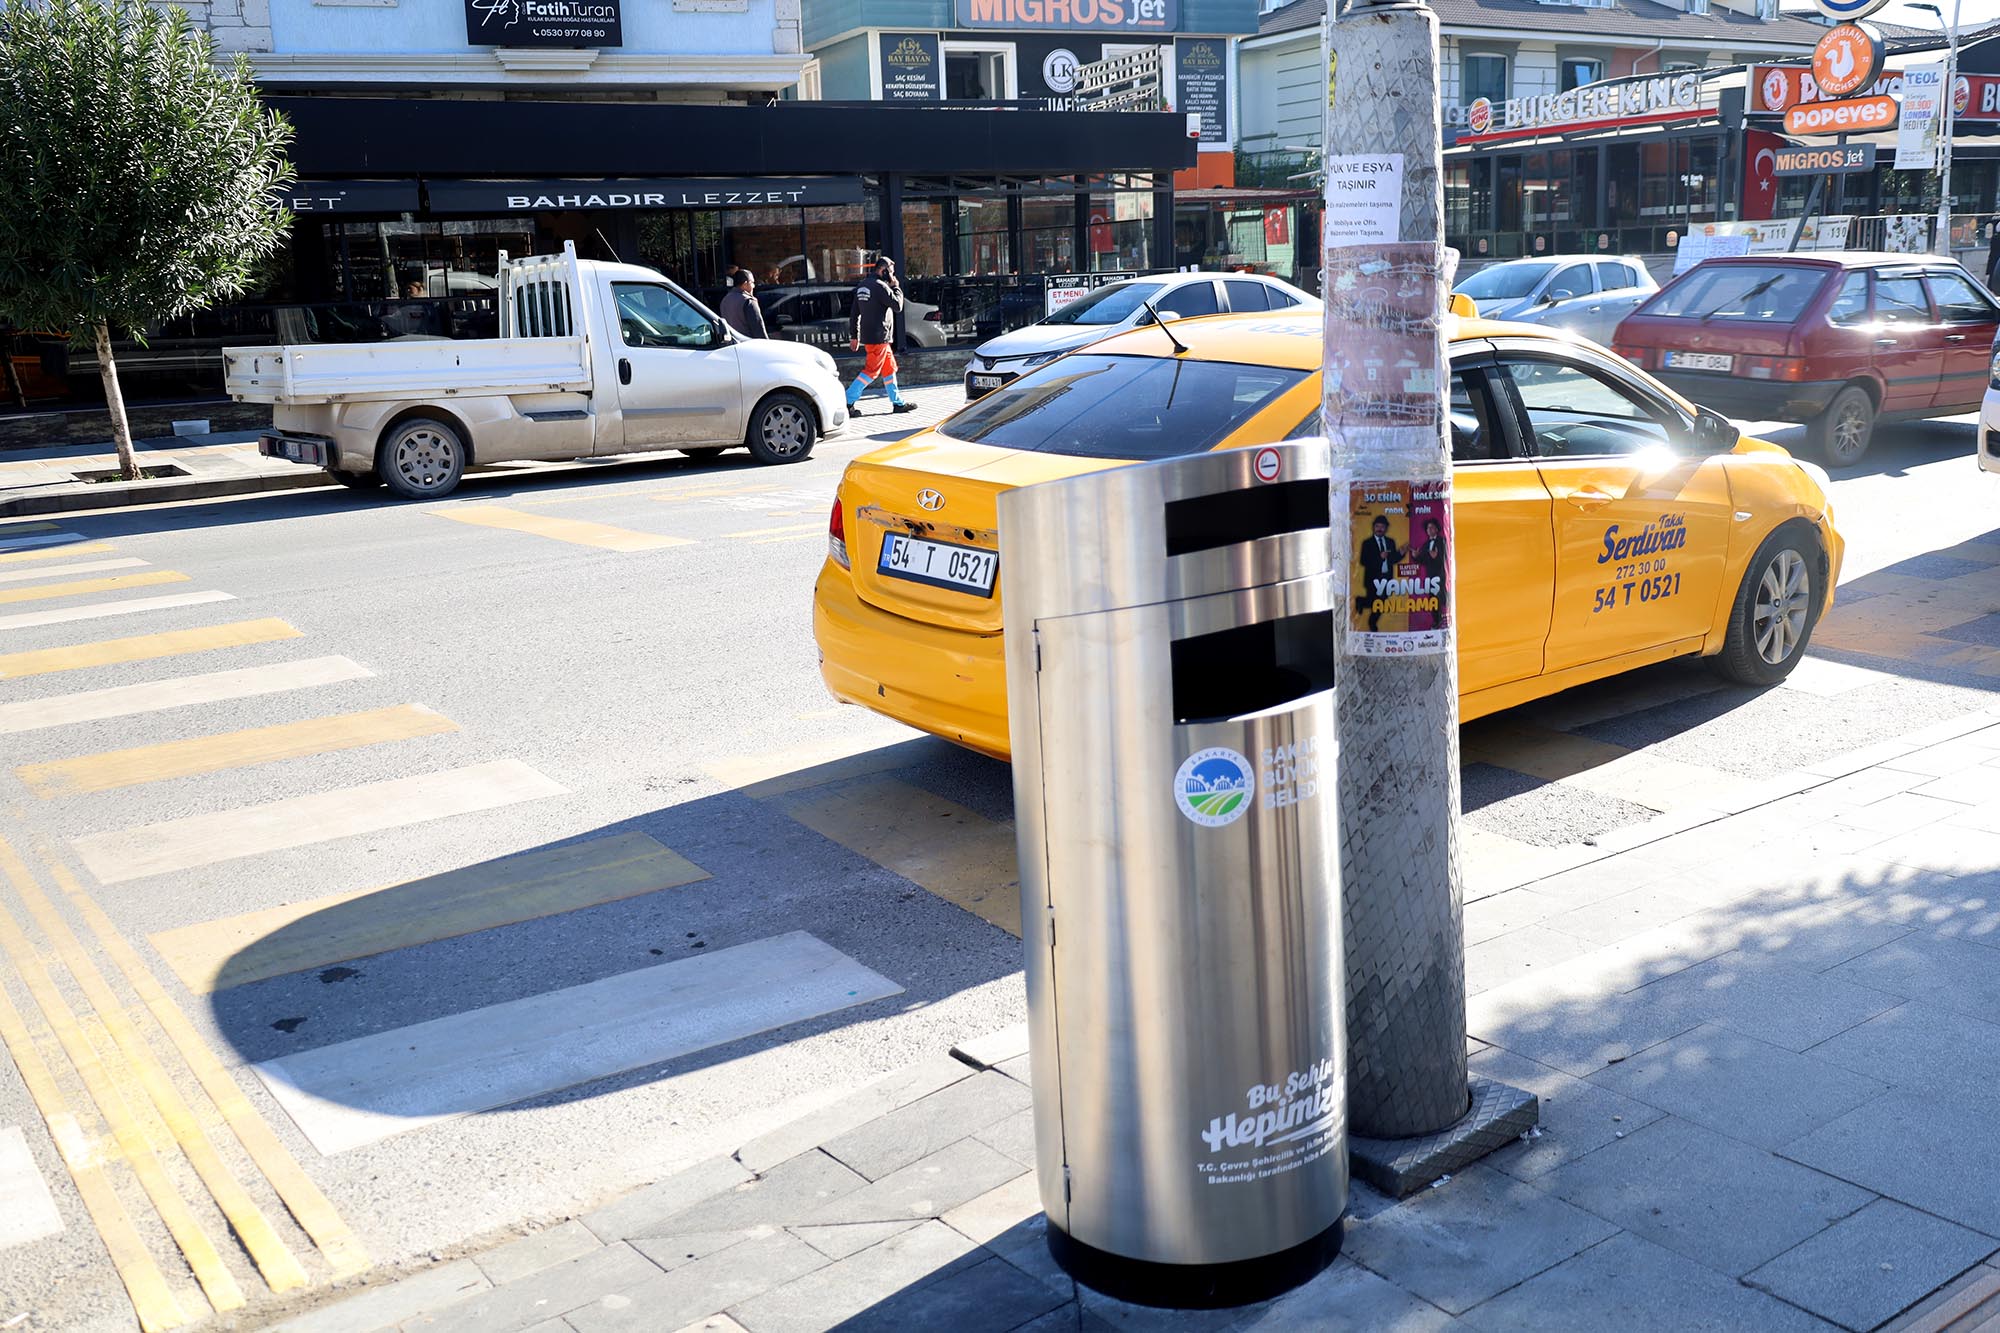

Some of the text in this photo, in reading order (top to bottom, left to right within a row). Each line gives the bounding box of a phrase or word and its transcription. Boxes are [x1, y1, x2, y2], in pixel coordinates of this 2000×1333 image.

[540, 29, 562, 37] 0530
[564, 29, 579, 37] 977
[1820, 28, 1866, 50] LOUISIANA
[1050, 63, 1073, 78] LK
[1820, 74, 1861, 92] KITCHEN
[1504, 73, 1698, 128] BURGER KING
[1471, 111, 1488, 125] KING
[1844, 149, 1864, 167] jet
[1346, 163, 1360, 173] VE
[1362, 162, 1394, 174] EŞYA
[1337, 180, 1376, 191] TAŞINIR
[506, 191, 804, 208] BAHADIR LEZZET
[1064, 289, 1084, 297] MENÜ
[1659, 512, 1686, 529] Taksi
[1597, 524, 1686, 564] Serdivan
[892, 540, 910, 568] 54
[926, 546, 936, 573] T
[949, 551, 991, 585] 0521
[1616, 558, 1666, 580] 272 30 00
[1373, 576, 1441, 596] YANLIŞ
[1593, 572, 1681, 614] 54 T 0521
[1372, 597, 1439, 613] ANLAMA
[1246, 1058, 1333, 1110] Bu Şehir
[1197, 1162, 1217, 1172] T.C.
[1220, 1160, 1249, 1173] Çevre
[1252, 1149, 1294, 1169] Şehircilik
[1208, 1172, 1256, 1184] Bakanlığı
[1258, 1158, 1302, 1179] tarafından
